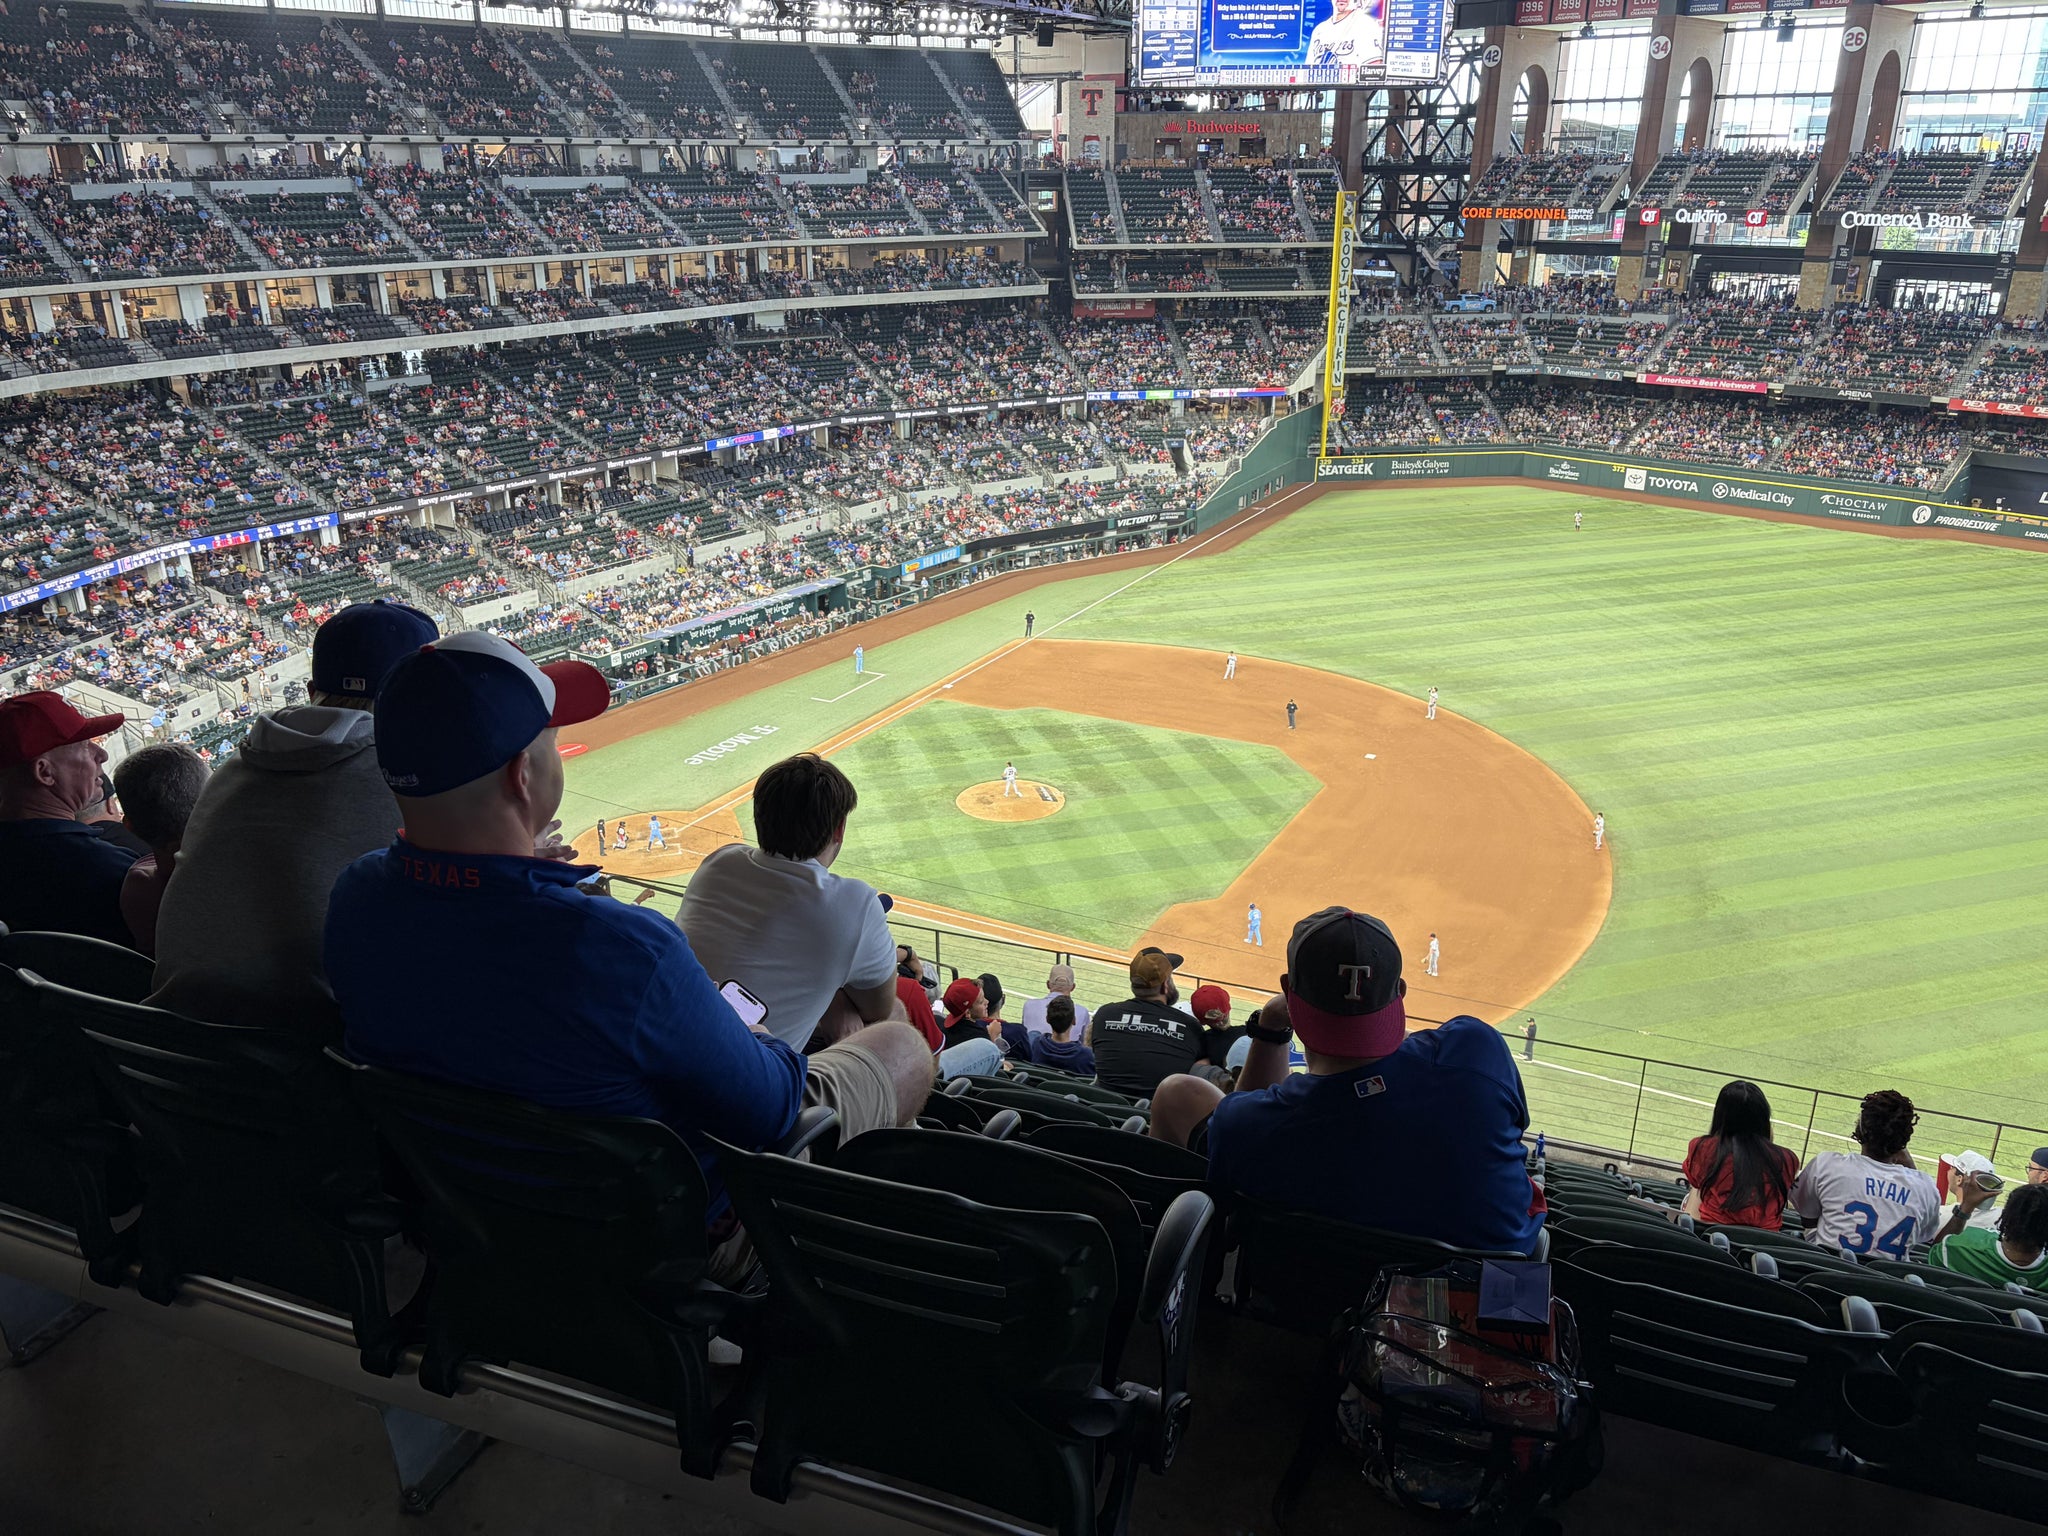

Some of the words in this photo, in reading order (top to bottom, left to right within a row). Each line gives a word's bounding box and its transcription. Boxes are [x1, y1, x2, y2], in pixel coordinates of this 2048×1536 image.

[1521, 1, 1544, 13] 1996
[1558, 0, 1581, 10] 1998
[1844, 32, 1864, 46] 26
[1652, 40, 1669, 55] 34
[1484, 50, 1500, 63] 42
[1361, 66, 1386, 77] Harvey
[1081, 88, 1104, 117] T
[1461, 207, 1493, 219] CORE
[1495, 208, 1568, 220] PERSONNEL
[1641, 210, 1658, 223] QT
[1675, 208, 1728, 225] QuikTrip
[1747, 211, 1765, 225] QT
[1927, 212, 1976, 229] Bank
[1334, 309, 1346, 383] CHIKIN
[1379, 368, 1402, 376] SHIFT
[1437, 367, 1459, 375] SHIFT
[1508, 367, 1534, 375] American
[1566, 369, 1591, 377] American
[1655, 375, 1698, 386] America's
[1698, 378, 1719, 388] Best
[1719, 380, 1757, 391] Network
[1837, 389, 1873, 399] ARENA
[1962, 399, 1988, 408] DEX
[1997, 403, 2024, 412] DEX
[1318, 462, 1375, 476] SEATGEEK
[1611, 465, 1626, 473] 372
[485, 483, 505, 493] Harvey
[1648, 476, 1699, 493] TOYOTA
[417, 496, 439, 507] Harvey
[1824, 494, 1888, 511] CHOCTAW
[343, 511, 367, 521] Harvey
[1117, 514, 1155, 527] VICTORY
[1934, 515, 2002, 531] PROGRESSIVE
[773, 601, 795, 616] Kroger
[737, 612, 760, 627] Kroger
[699, 624, 722, 638] Kroger
[623, 647, 648, 659] TOYOTA
[400, 856, 480, 889] TEXAS
[1338, 964, 1372, 1000] T
[1105, 1014, 1187, 1032] JLT
[1105, 1023, 1185, 1041] PERFORMANCE
[1865, 1177, 1911, 1206] RYAN
[1838, 1200, 1917, 1261] 34
